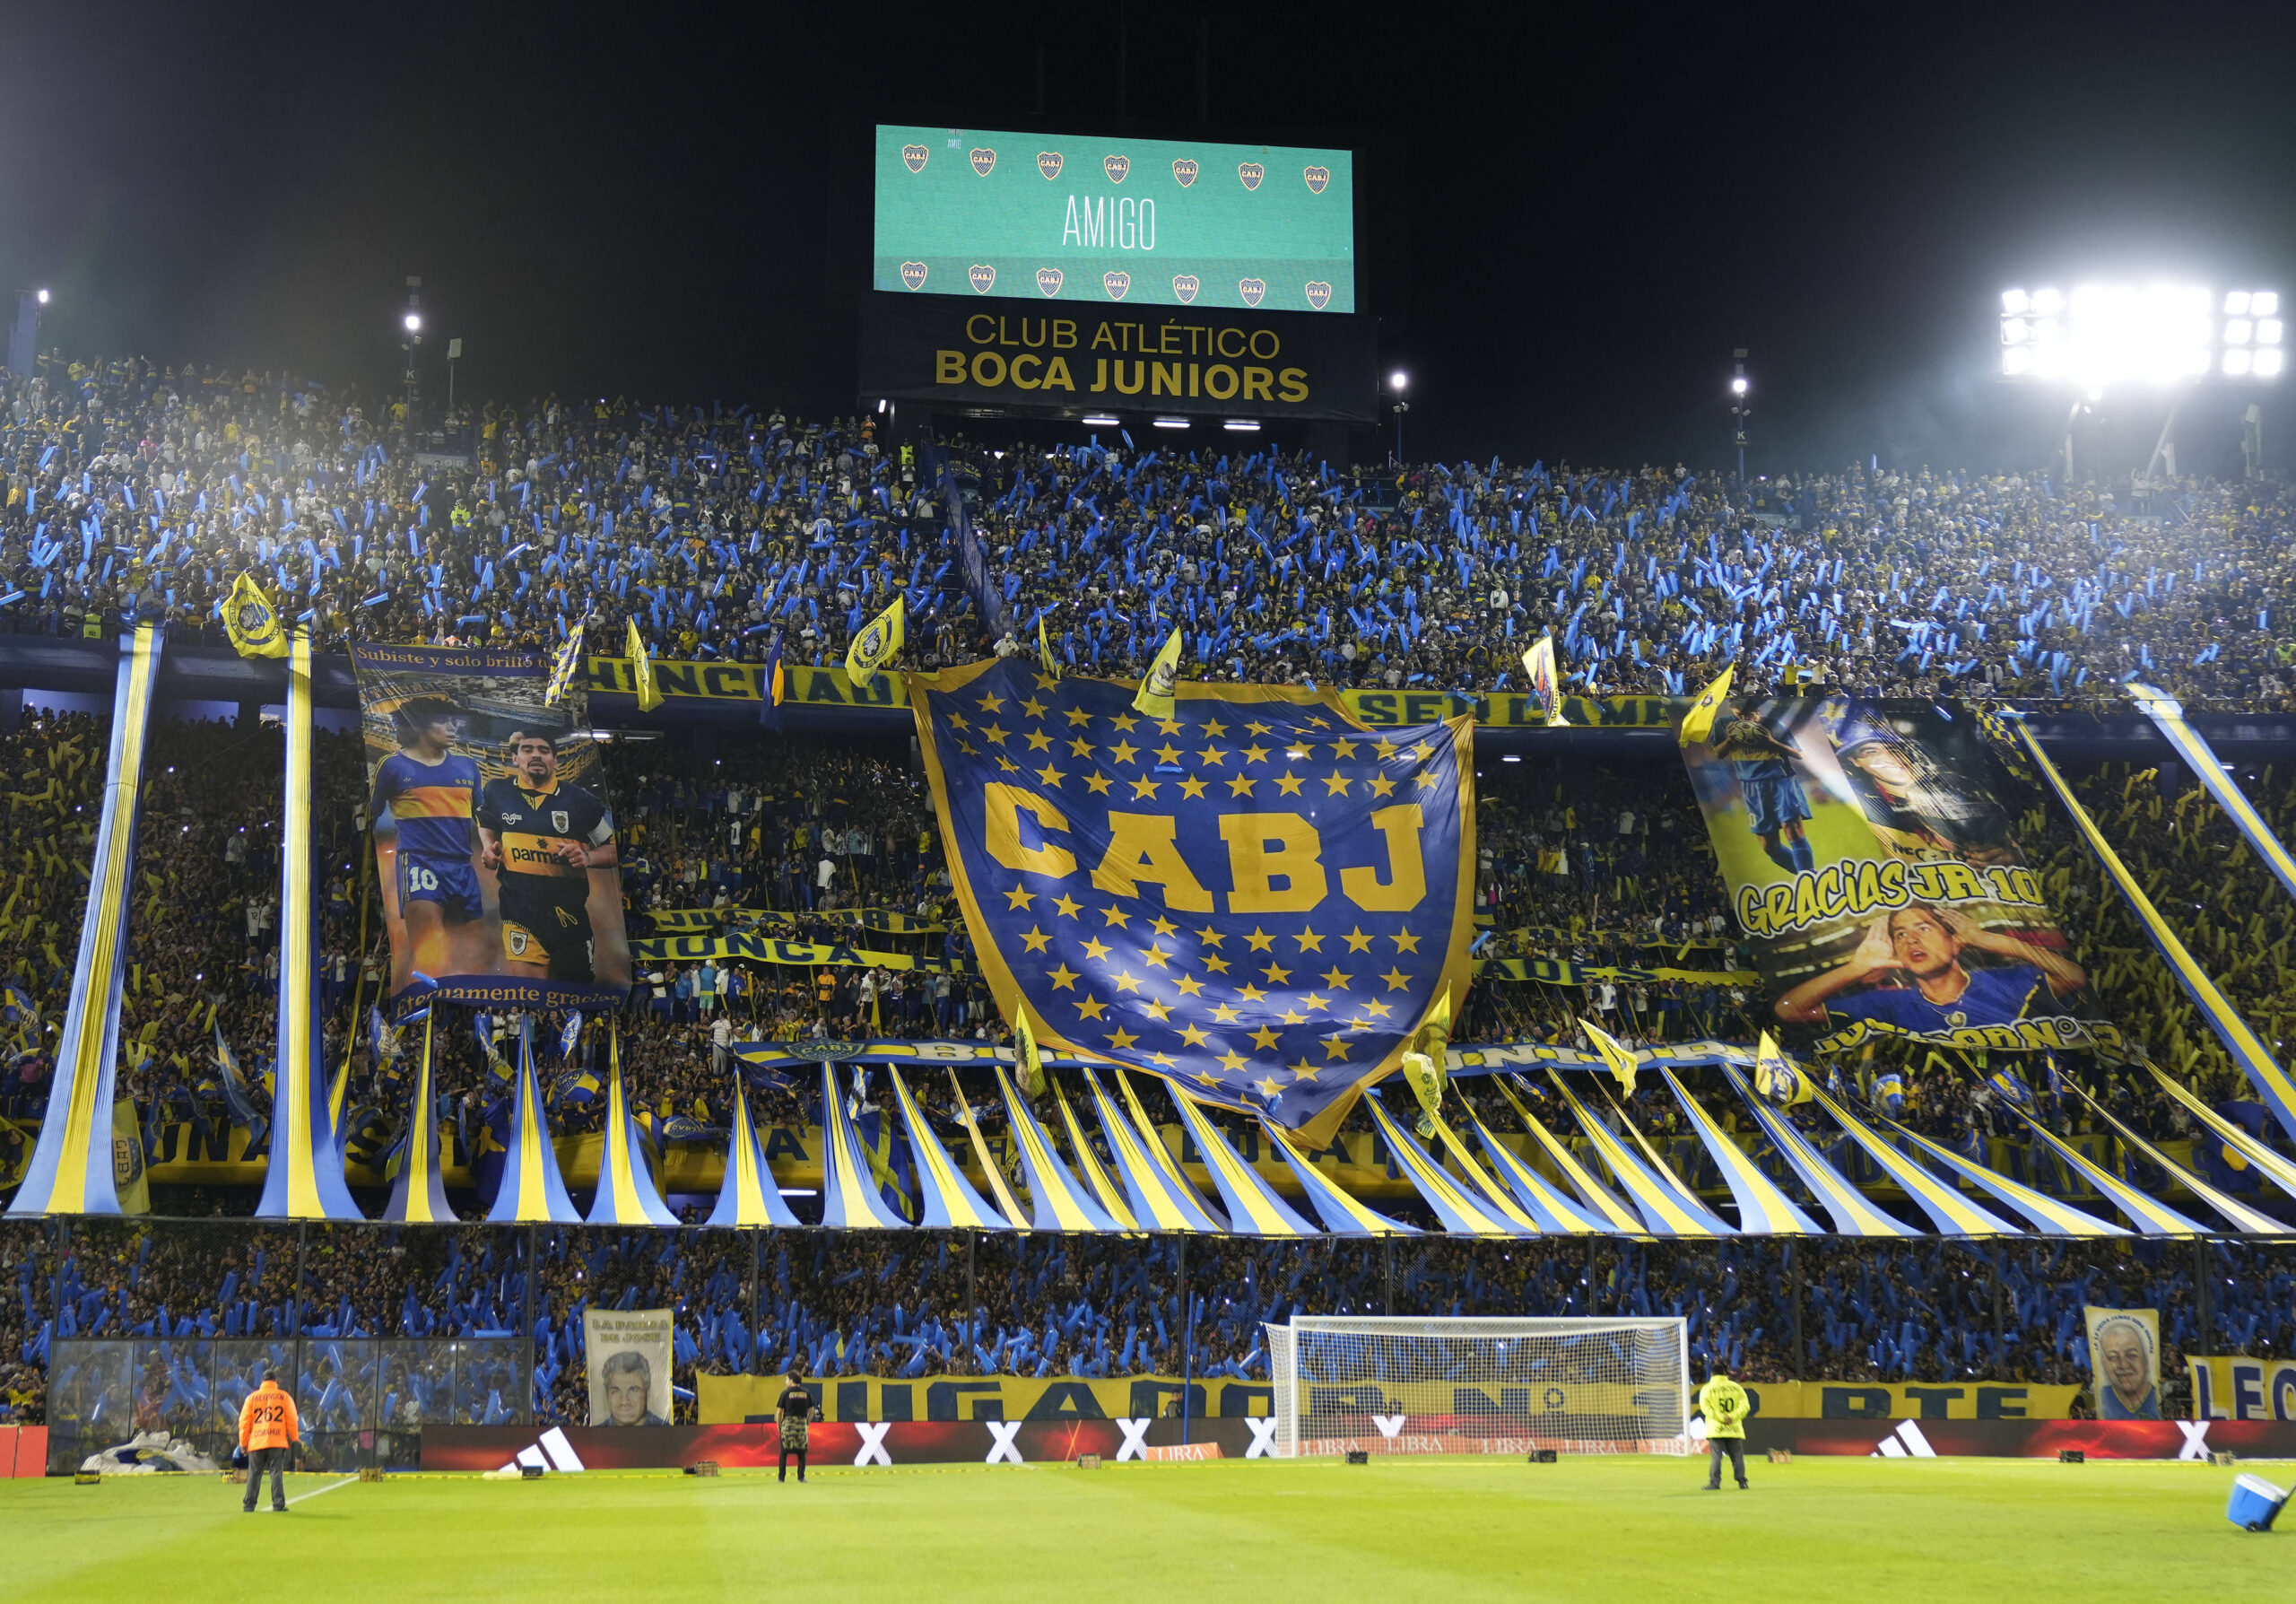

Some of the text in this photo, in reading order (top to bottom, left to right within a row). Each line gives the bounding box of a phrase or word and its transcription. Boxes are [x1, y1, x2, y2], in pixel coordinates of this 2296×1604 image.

[905, 153, 925, 161] CABJ
[973, 156, 993, 164] CABJ
[1039, 160, 1060, 168] CABJ
[1107, 163, 1126, 171] CABJ
[1176, 167, 1196, 175] CABJ
[1241, 170, 1261, 179] CABJ
[1307, 174, 1326, 182] CABJ
[1062, 195, 1155, 250] AMIGO
[904, 269, 925, 278] CABJ
[971, 272, 992, 281] CABJ
[1039, 275, 1060, 284] CABJ
[1107, 279, 1127, 288] CABJ
[1176, 283, 1197, 291] CABJ
[1242, 285, 1263, 294] CABJ
[1309, 289, 1328, 298] CABJ
[966, 314, 1281, 360] CLUB ATLÉTICO
[406, 370, 415, 379] K
[935, 350, 1309, 403] BOCA JUNIORS
[1736, 431, 1746, 440] K
[356, 647, 424, 665] Subiste
[430, 656, 440, 667] y
[445, 655, 482, 667] solo
[985, 780, 1427, 913] CABJ
[409, 867, 439, 893] 10
[1909, 862, 1989, 900] JR
[1985, 866, 2046, 905] 10
[630, 934, 865, 965] NUNCA
[1718, 1397, 1735, 1414] 50
[253, 1405, 284, 1425] 262
[1304, 1438, 1360, 1455] LIBRA
[1386, 1435, 1443, 1453] LIBRA
[1482, 1437, 1536, 1454] LIBRA
[1563, 1439, 1617, 1454] LIBRA
[1650, 1439, 1702, 1455] LIBA
[1157, 1444, 1204, 1460] LIBRA
